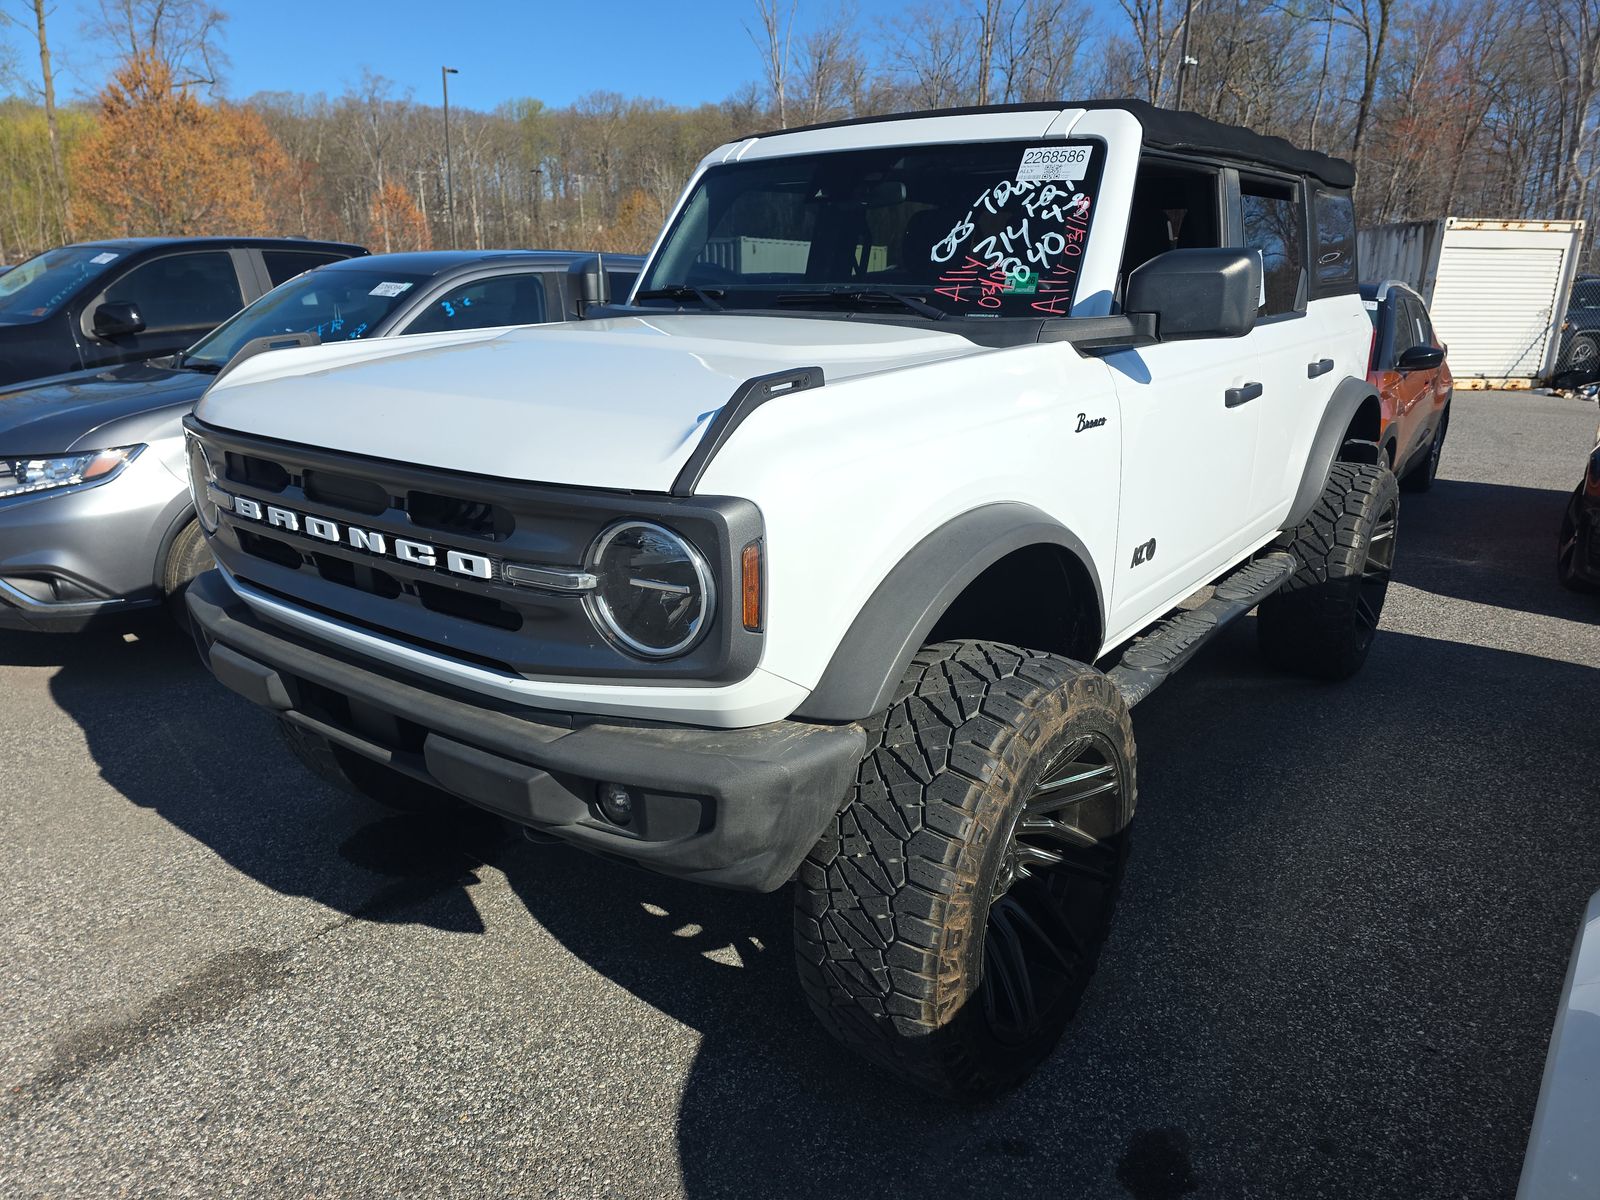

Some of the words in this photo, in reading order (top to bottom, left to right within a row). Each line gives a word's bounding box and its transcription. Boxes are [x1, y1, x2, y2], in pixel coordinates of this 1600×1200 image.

[1024, 149, 1086, 165] 2268586
[972, 218, 1032, 270] 314
[1074, 412, 1108, 434] Bronco
[234, 496, 493, 579] BRONCO
